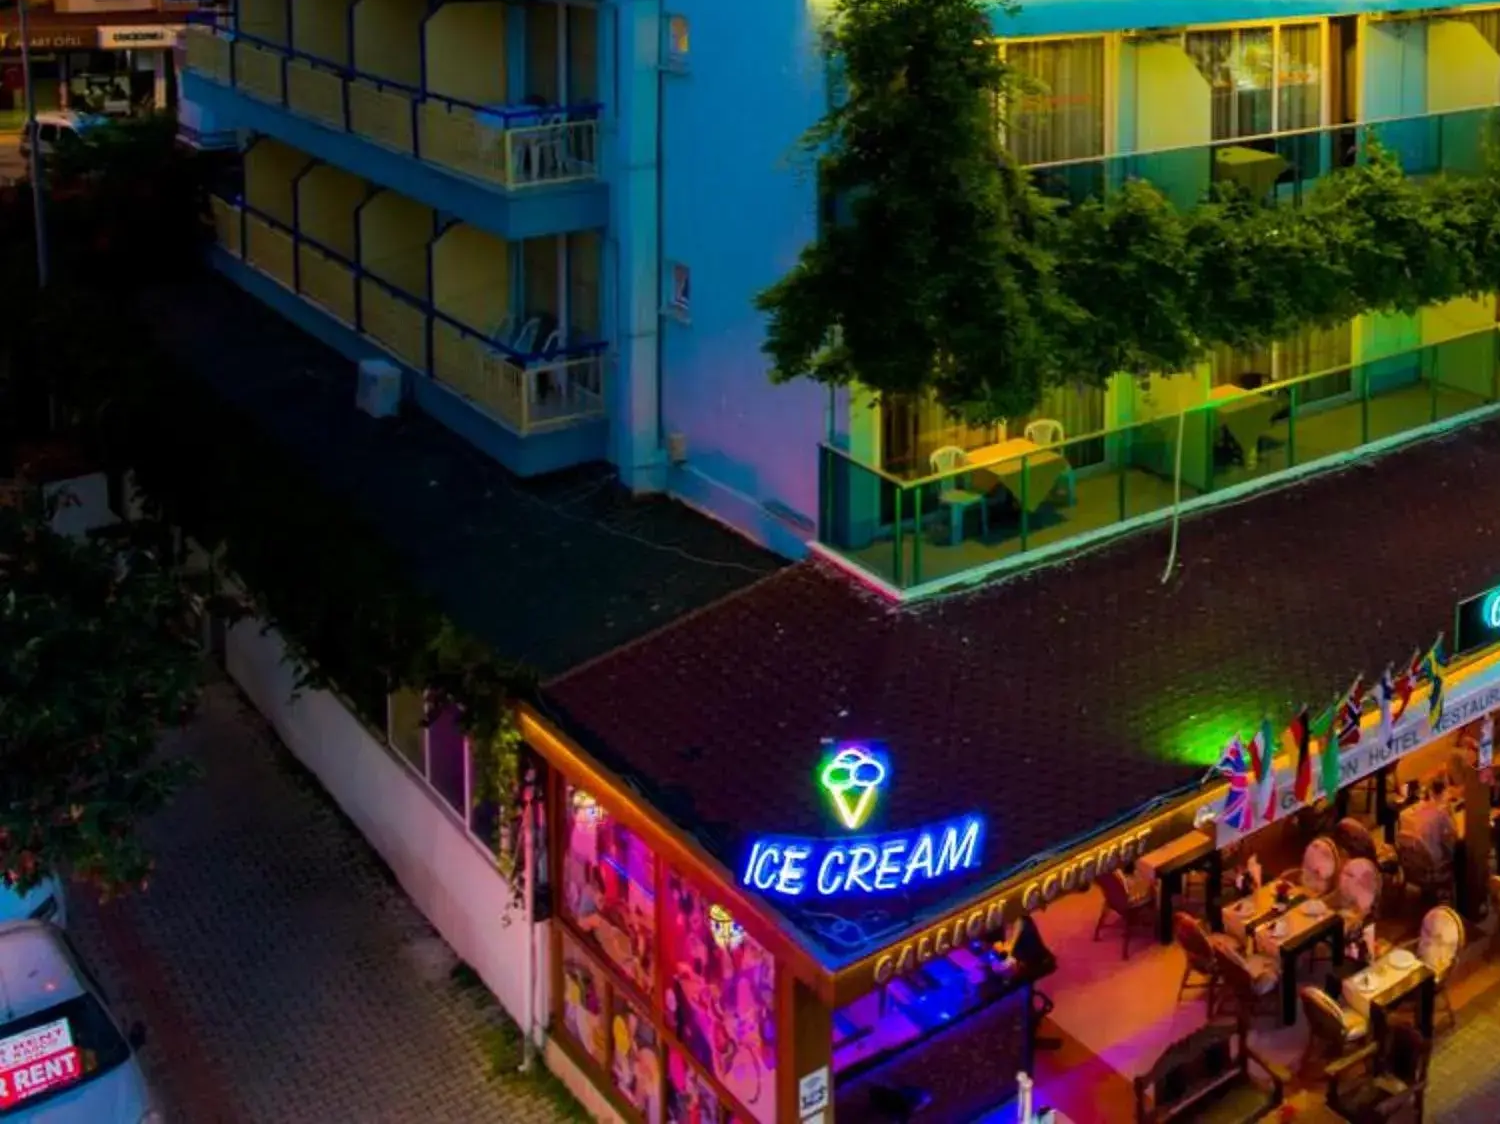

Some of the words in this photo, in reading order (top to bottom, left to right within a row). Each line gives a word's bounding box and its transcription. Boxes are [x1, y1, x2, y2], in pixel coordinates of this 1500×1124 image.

[743, 840, 812, 896] ICE
[817, 821, 980, 895] CREAM
[14, 1051, 77, 1093] RENT
